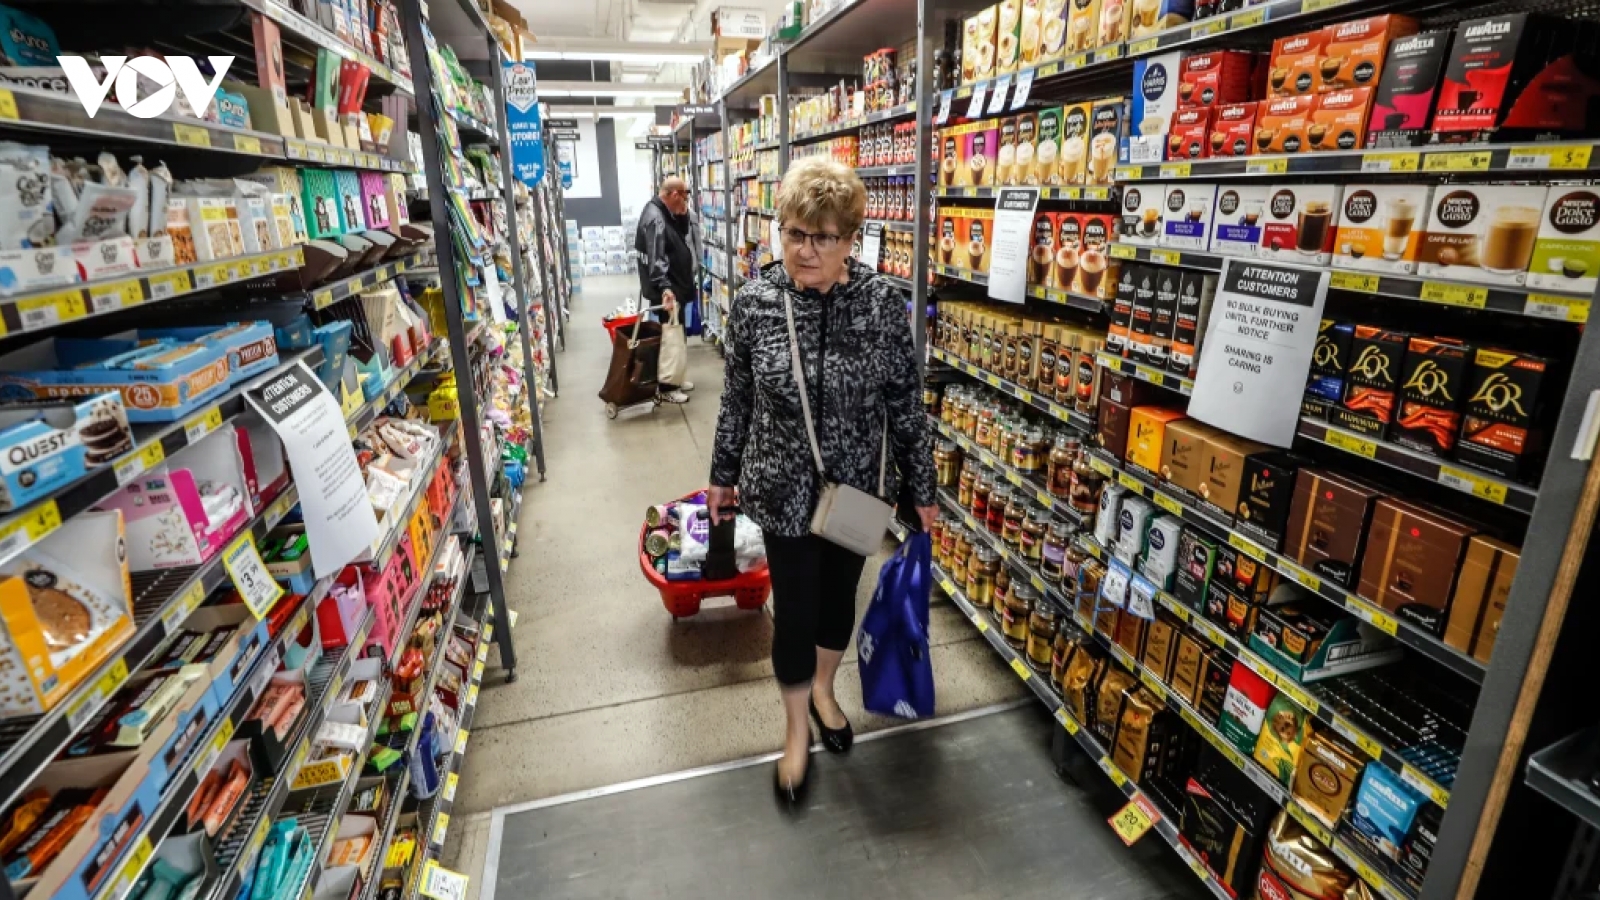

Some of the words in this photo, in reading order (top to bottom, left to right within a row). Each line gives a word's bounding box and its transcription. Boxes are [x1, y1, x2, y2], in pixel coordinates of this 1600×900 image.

[1336, 22, 1370, 37] LAVAZZA
[1464, 21, 1511, 37] LAVAZZA
[1394, 37, 1435, 53] LAVAZZA
[1441, 210, 1473, 222] Gusto
[1443, 203, 1474, 214] Dolce
[1556, 205, 1596, 218] Dolce
[1554, 212, 1595, 226] Gusto
[1539, 241, 1596, 252] CAPPUCCINO
[1242, 266, 1300, 285] ATTENTION
[1237, 278, 1299, 299] CUSTOMERS
[1238, 301, 1262, 315] BULK
[1262, 306, 1299, 322] BUYING
[1237, 325, 1270, 341] NOTICE
[1250, 315, 1294, 334] FURTHER
[1224, 344, 1262, 362] SHARING
[1263, 354, 1273, 365] IS
[1228, 357, 1261, 374] CARING
[263, 373, 299, 403] ATTENTION
[271, 384, 313, 415] CUSTOMERS
[9, 432, 67, 466] QUEST
[1368, 777, 1408, 812] LAVAZZA
